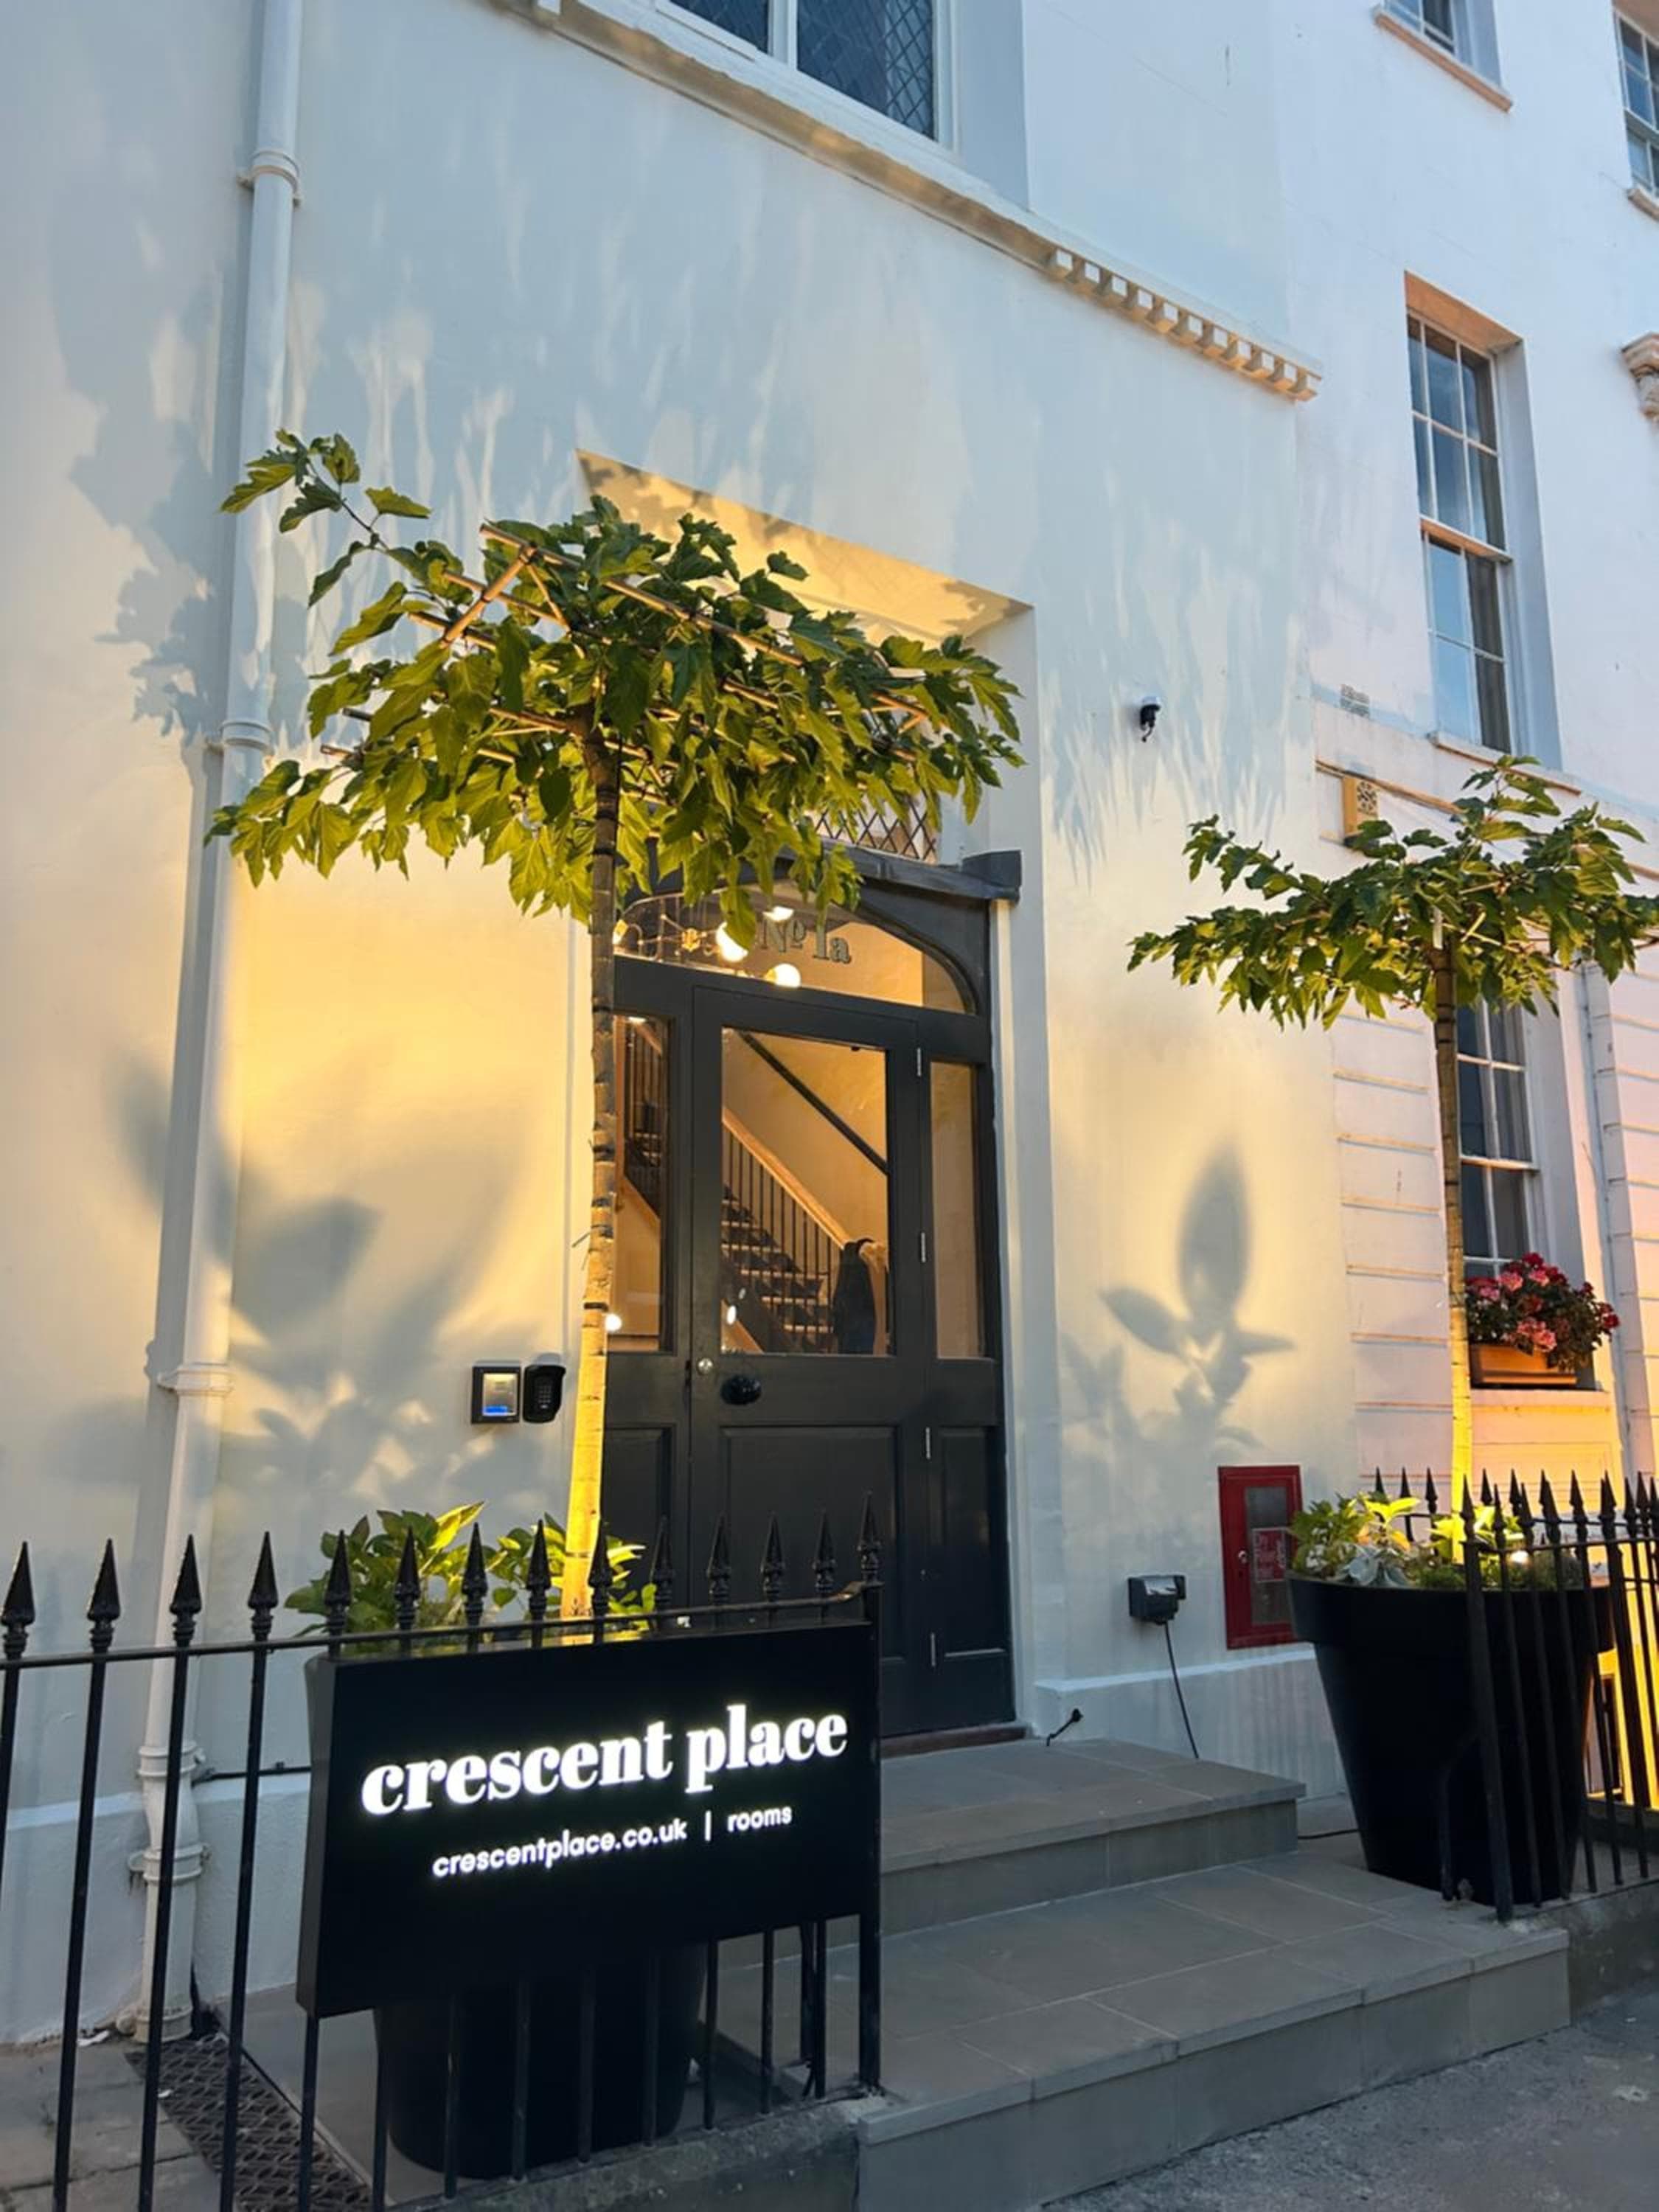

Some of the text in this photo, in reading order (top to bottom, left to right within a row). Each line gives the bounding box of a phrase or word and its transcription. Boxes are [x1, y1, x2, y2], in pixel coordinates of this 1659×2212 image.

[362, 1704, 847, 1815] crescent place
[433, 1818, 687, 1877] crescentplace.co.uk
[728, 1806, 792, 1832] rooms
